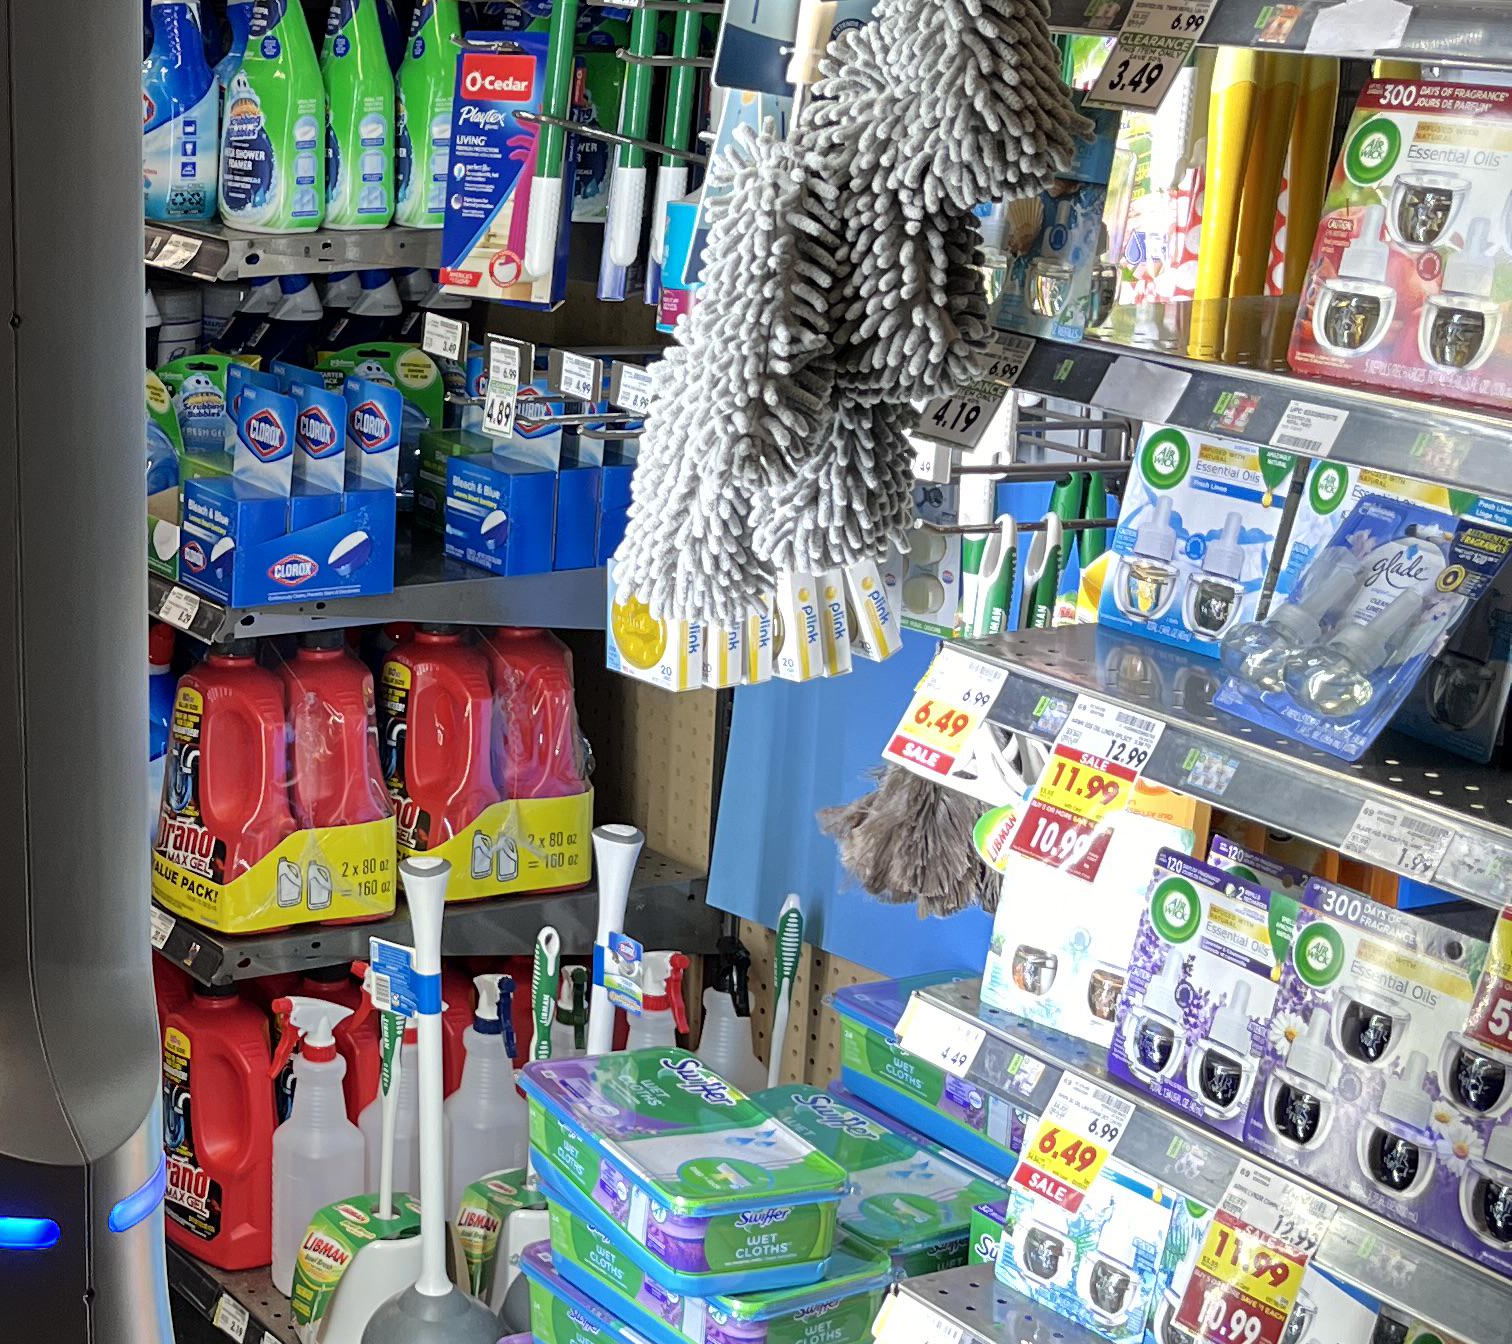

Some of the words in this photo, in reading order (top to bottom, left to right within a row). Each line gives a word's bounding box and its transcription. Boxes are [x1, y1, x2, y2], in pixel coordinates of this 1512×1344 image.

[1170, 14, 1206, 33] 6.99
[1120, 32, 1191, 52] CLEARANCE
[465, 68, 530, 95] O-Cedar
[1108, 59, 1165, 94] 3.49
[1378, 84, 1418, 107] 300
[1420, 86, 1439, 97] DAYS
[1440, 87, 1452, 97] OF
[458, 105, 506, 129] Playtex
[455, 134, 487, 147] LIVING
[1406, 143, 1472, 162] Essential
[1473, 148, 1502, 168] Oils
[502, 367, 518, 382] 6.99
[989, 361, 1020, 381] 6.99
[574, 377, 593, 395] 4.99
[353, 408, 387, 440] CLOROX
[486, 399, 512, 425] 4.89
[931, 398, 982, 434] 4.19
[250, 421, 282, 450] CLOROX
[300, 417, 332, 446] CLOROX
[1196, 461, 1244, 481] Essential
[1244, 471, 1261, 484] Oils
[273, 561, 314, 582] CLOROX
[1363, 550, 1430, 590] glade
[828, 600, 848, 641] plink
[869, 589, 890, 626] plink
[801, 604, 818, 645] plink
[962, 687, 991, 709] 6.99
[912, 700, 970, 739] 6.49
[902, 742, 940, 767] SALE
[1079, 753, 1110, 770] SALE
[1105, 739, 1148, 769] 12.99
[1053, 762, 1120, 806] 11.99
[1029, 817, 1089, 860] 10.99
[167, 849, 189, 869] MAX
[190, 857, 213, 876] GEL
[180, 874, 220, 903] PACK!
[358, 879, 378, 897] 160
[381, 881, 391, 893] oz
[1322, 887, 1362, 922] 300
[1363, 903, 1385, 921] DAYS
[1205, 921, 1249, 947] Essential
[1250, 939, 1270, 958] Oils
[1359, 915, 1417, 946] FRAGRANCE
[1350, 960, 1409, 994] Essential
[1411, 984, 1438, 1007] Oils
[660, 1057, 737, 1108] Swiffer
[885, 1063, 923, 1090] CLOTHS
[791, 1093, 880, 1141] Swiffer
[1087, 1117, 1119, 1143] 6.99
[1038, 1127, 1098, 1173] 6.49
[1028, 1172, 1068, 1203] SALE
[457, 1208, 500, 1233] LIBMAN
[735, 1207, 793, 1228] Swiffer
[303, 1231, 352, 1266] LIBMAN
[735, 1243, 793, 1259] CLOTHS
[746, 1232, 778, 1248] WET
[1214, 1229, 1291, 1289] 11.99
